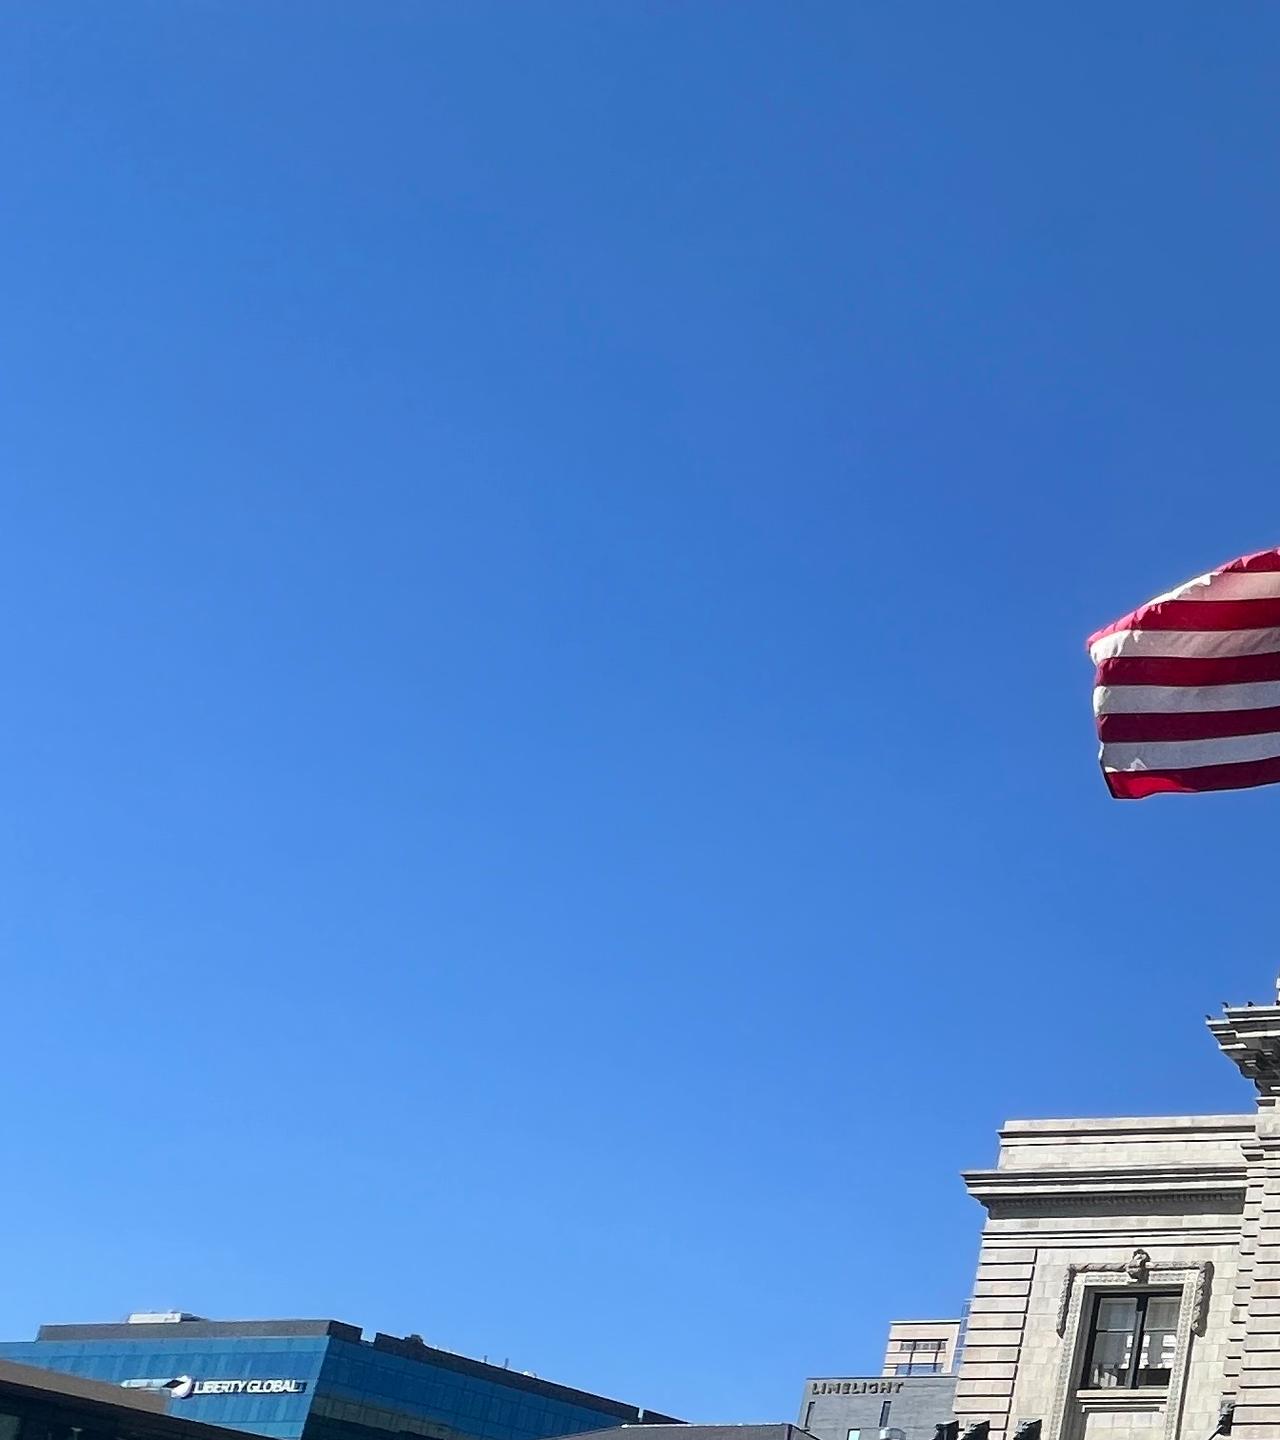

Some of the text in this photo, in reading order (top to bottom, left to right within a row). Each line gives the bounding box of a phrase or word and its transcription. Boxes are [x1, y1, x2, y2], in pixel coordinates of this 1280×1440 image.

[193, 1379, 301, 1394] LIBERTY GLOBAL
[811, 1381, 905, 1396] LIMELIGHT
